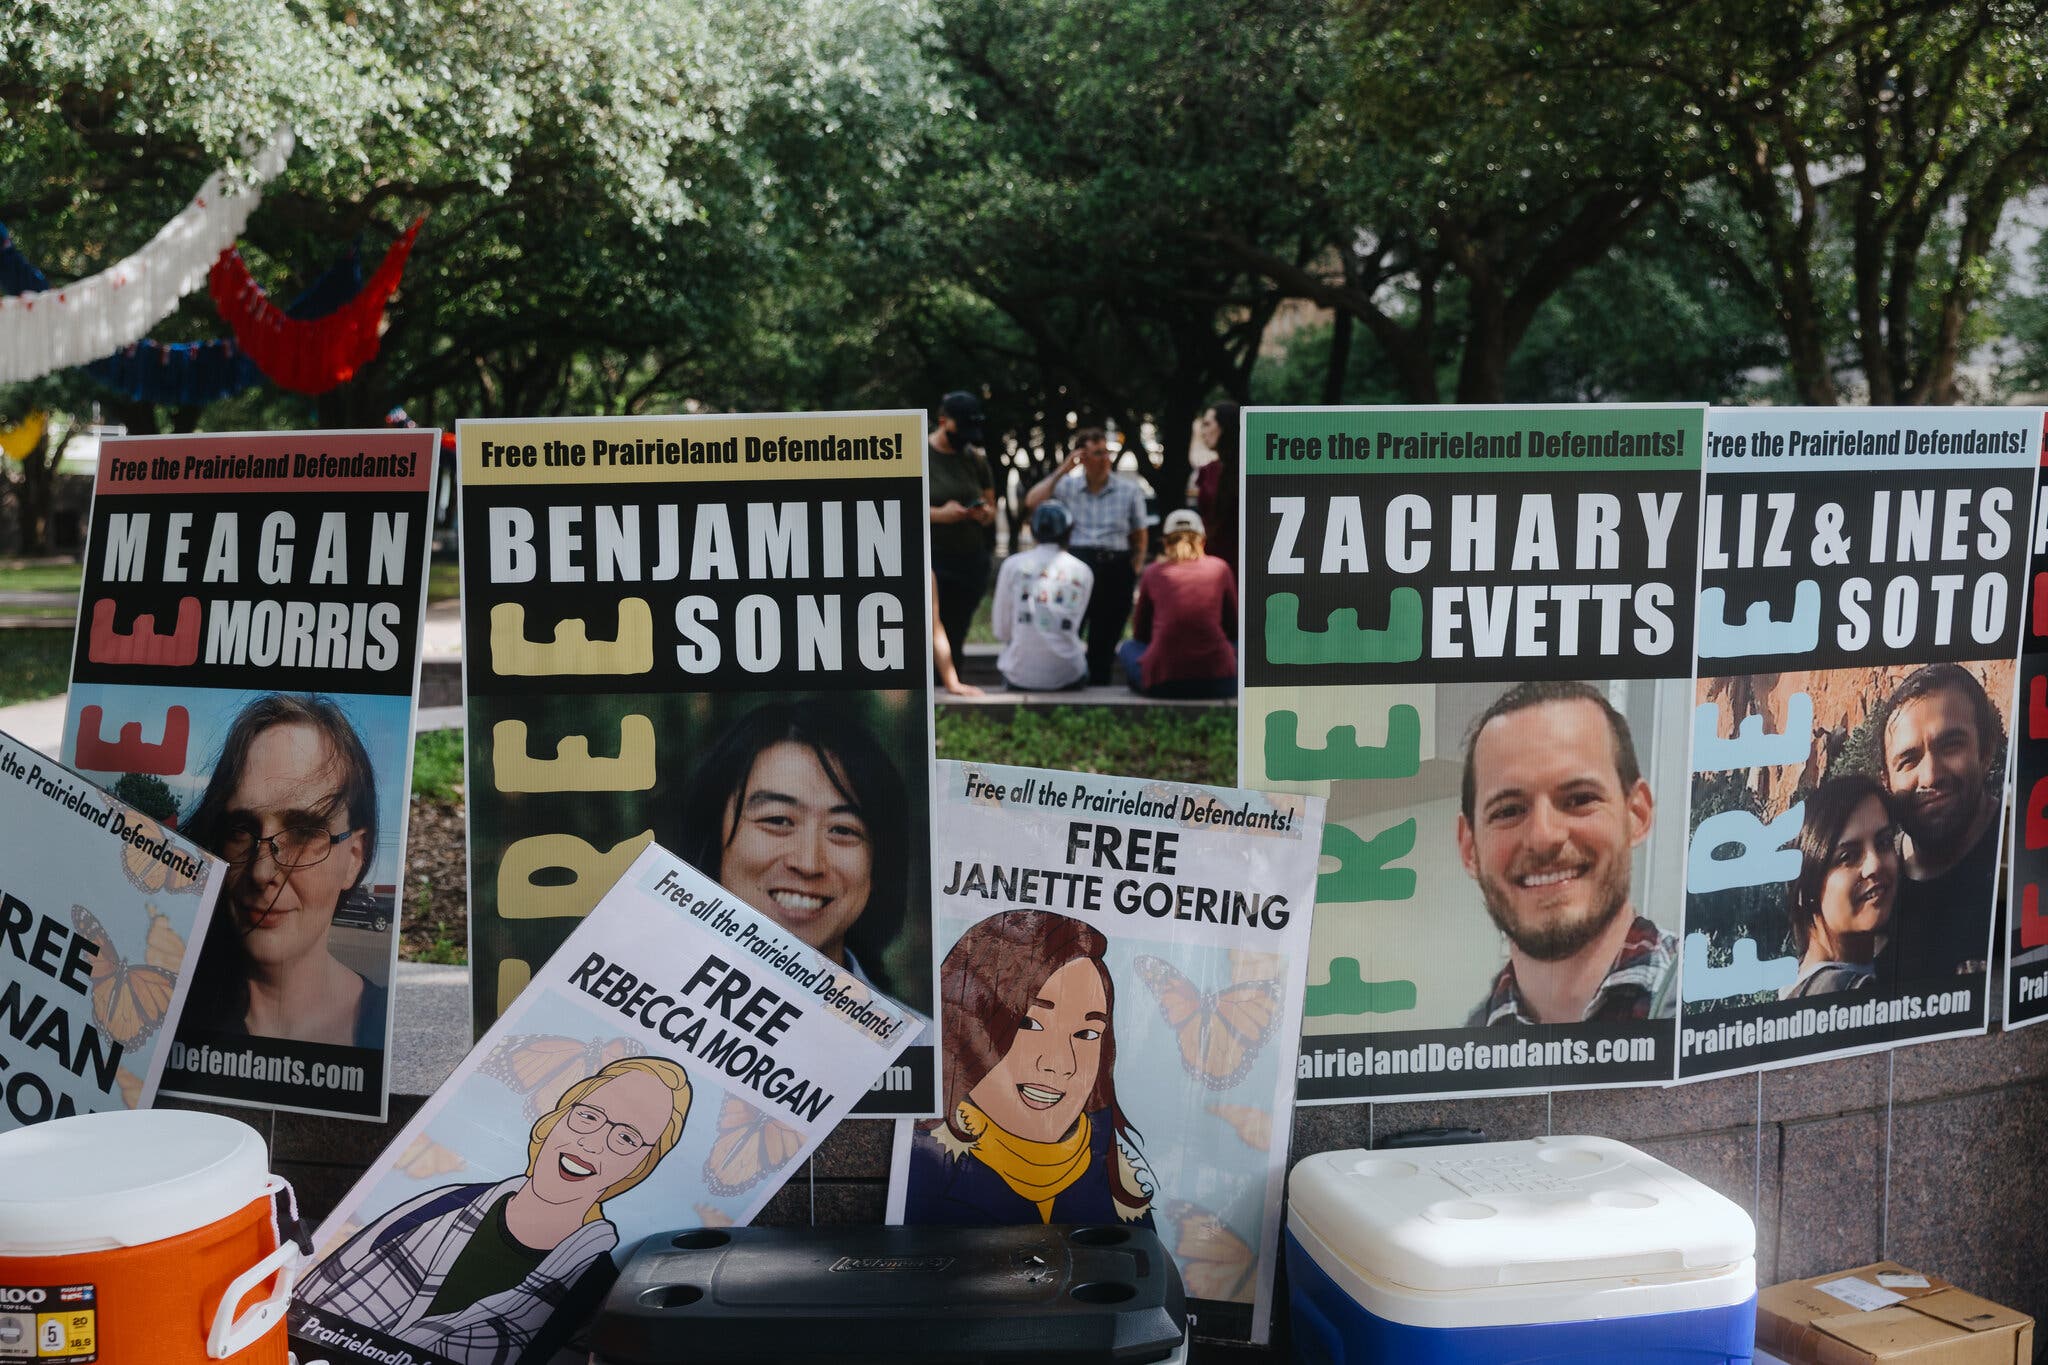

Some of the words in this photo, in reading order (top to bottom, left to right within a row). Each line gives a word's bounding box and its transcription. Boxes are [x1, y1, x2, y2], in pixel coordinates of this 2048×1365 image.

[110, 456, 146, 482] Free
[151, 455, 180, 480] the
[184, 453, 289, 480] Prairieland
[293, 452, 417, 480] Defendants!
[482, 440, 537, 468] Free
[543, 440, 586, 467] the
[592, 437, 739, 467] Prairieland
[745, 433, 903, 464] Defendants!
[1266, 432, 1322, 461] Free
[1327, 432, 1370, 460] the
[1376, 430, 1522, 460] Prairieland
[1528, 429, 1685, 459] Defendants!
[1751, 431, 1784, 458] the
[1788, 429, 1901, 457] Prairieland
[1904, 428, 2029, 456] Defendants!
[102, 510, 409, 586] MEAGAN
[488, 499, 903, 584] BENJAMIN
[1267, 492, 1684, 574] ZACHARY
[1703, 492, 1796, 571] LIZ
[1810, 502, 1852, 567] &
[1869, 487, 2014, 565] INES
[204, 599, 401, 671] MORRIS
[675, 591, 905, 675] SONG
[1431, 581, 1676, 658] EVETTS
[1836, 571, 2009, 652] SOTO
[1, 752, 26, 780] the
[26, 764, 114, 829] Prairieland
[110, 813, 204, 882] Defendants!
[489, 596, 656, 1020] REE
[965, 773, 1006, 801] Free
[1010, 778, 1036, 805] all
[1038, 780, 1068, 809] the
[1071, 785, 1178, 821] Prairieland
[1180, 796, 1296, 832] Defendants!
[1682, 579, 1821, 1004] FREE
[1065, 821, 1179, 876] FREE
[942, 860, 1104, 911] JANETTE
[1113, 878, 1291, 931] GOERING
[0, 888, 101, 997] REE
[653, 869, 694, 908] Free
[690, 898, 723, 923] all
[711, 908, 740, 938] the
[734, 922, 826, 990] Prairieland
[813, 972, 903, 1040] Defendants!
[567, 951, 708, 1054] REBECCA
[697, 1028, 835, 1124] MORGAN
[680, 953, 804, 1048] FREE
[1681, 988, 1972, 1058] PrairielandDefendants.com
[166, 1040, 365, 1093] Defendants.com
[47, 1325, 57, 1343] 5
[72, 1316, 88, 1326] 20
